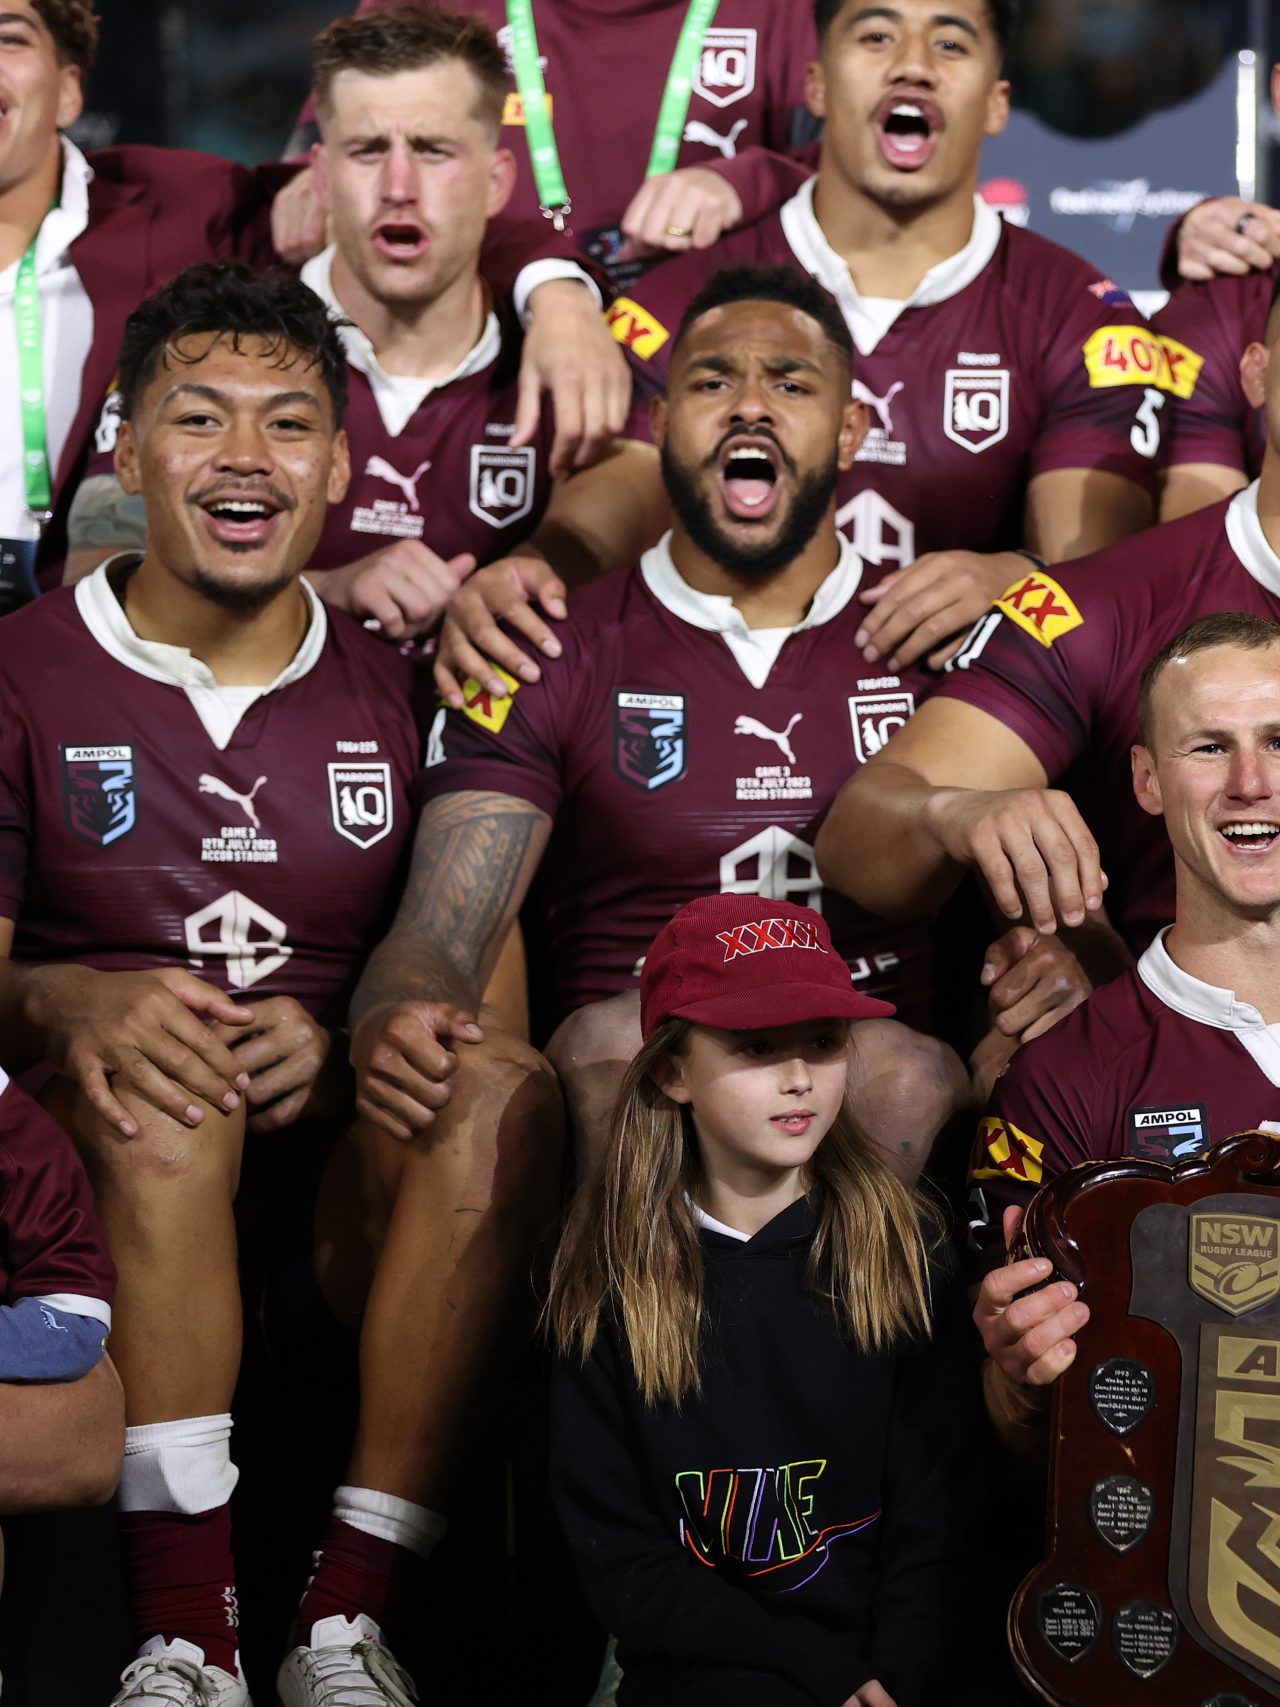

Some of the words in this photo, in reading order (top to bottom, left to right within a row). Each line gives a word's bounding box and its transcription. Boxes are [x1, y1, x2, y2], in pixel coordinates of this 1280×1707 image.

[1130, 387, 1166, 459] 5
[625, 696, 676, 708] AMPOL
[856, 701, 909, 716] MAROONS
[72, 750, 127, 759] AMPOL
[335, 771, 385, 783] MAROONS
[755, 766, 781, 778] GAME
[782, 765, 791, 777] 3
[735, 777, 760, 789] 12TH
[760, 776, 786, 789] JULY
[786, 776, 812, 788] 2023
[735, 788, 768, 800] ACCOR
[768, 787, 813, 800] STADIUM
[221, 826, 248, 839] GAME
[248, 826, 257, 839] 3
[201, 837, 225, 850] 12TH
[225, 838, 251, 851] JULY
[251, 838, 277, 851] 2023
[201, 849, 233, 862] ACCOR
[234, 849, 278, 863] STADIUM
[715, 918, 829, 963] XXXX
[1140, 1111, 1196, 1125] AMPOL
[1200, 1221, 1274, 1247] NSW
[1200, 1245, 1233, 1255] RUGBY
[1235, 1248, 1273, 1258] LEAGUE
